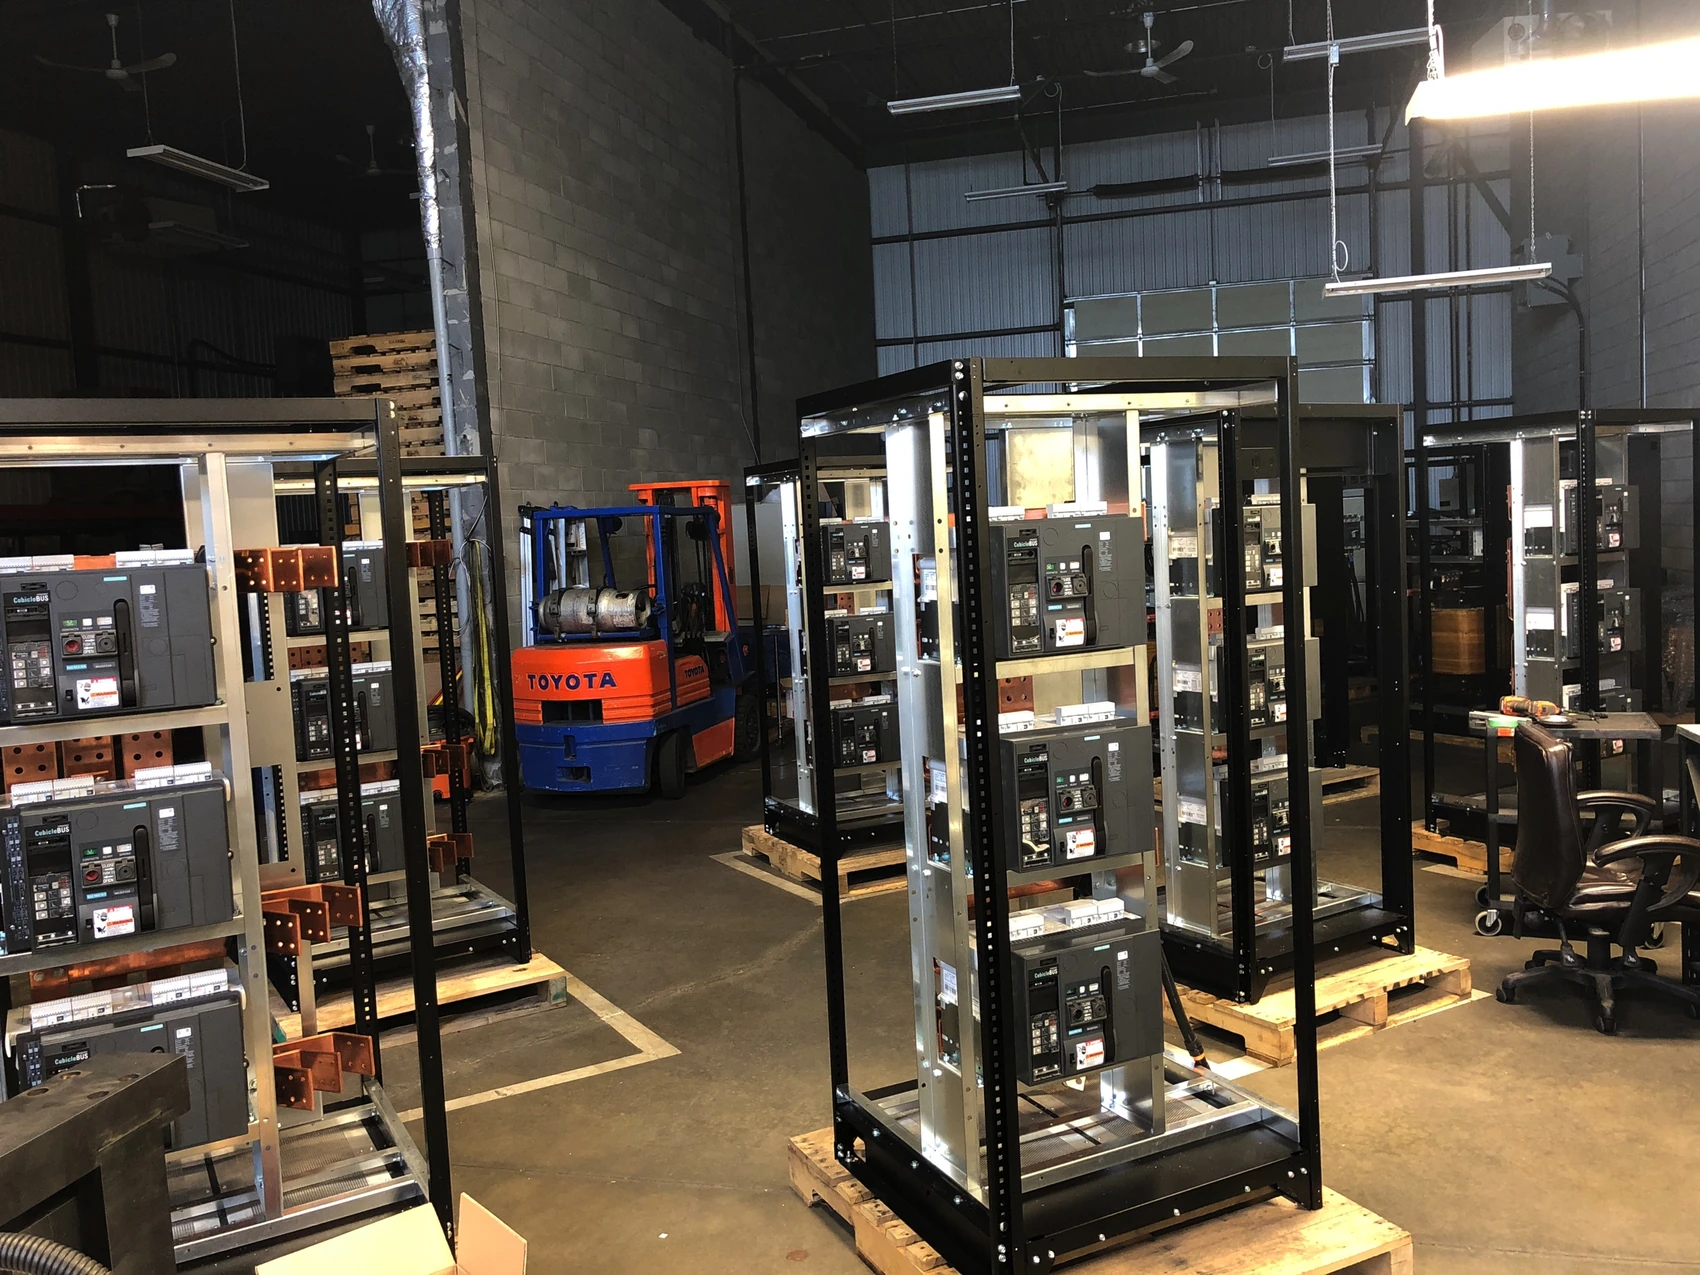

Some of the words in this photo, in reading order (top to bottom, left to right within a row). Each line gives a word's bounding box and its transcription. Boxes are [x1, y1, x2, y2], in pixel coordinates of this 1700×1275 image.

[13, 594, 49, 604] CubicleBUS
[684, 665, 704, 678] TOYOTA
[527, 671, 617, 691] TOYOTA
[35, 826, 70, 836] CubicleBUS
[55, 1052, 88, 1064] CubicleBUS
